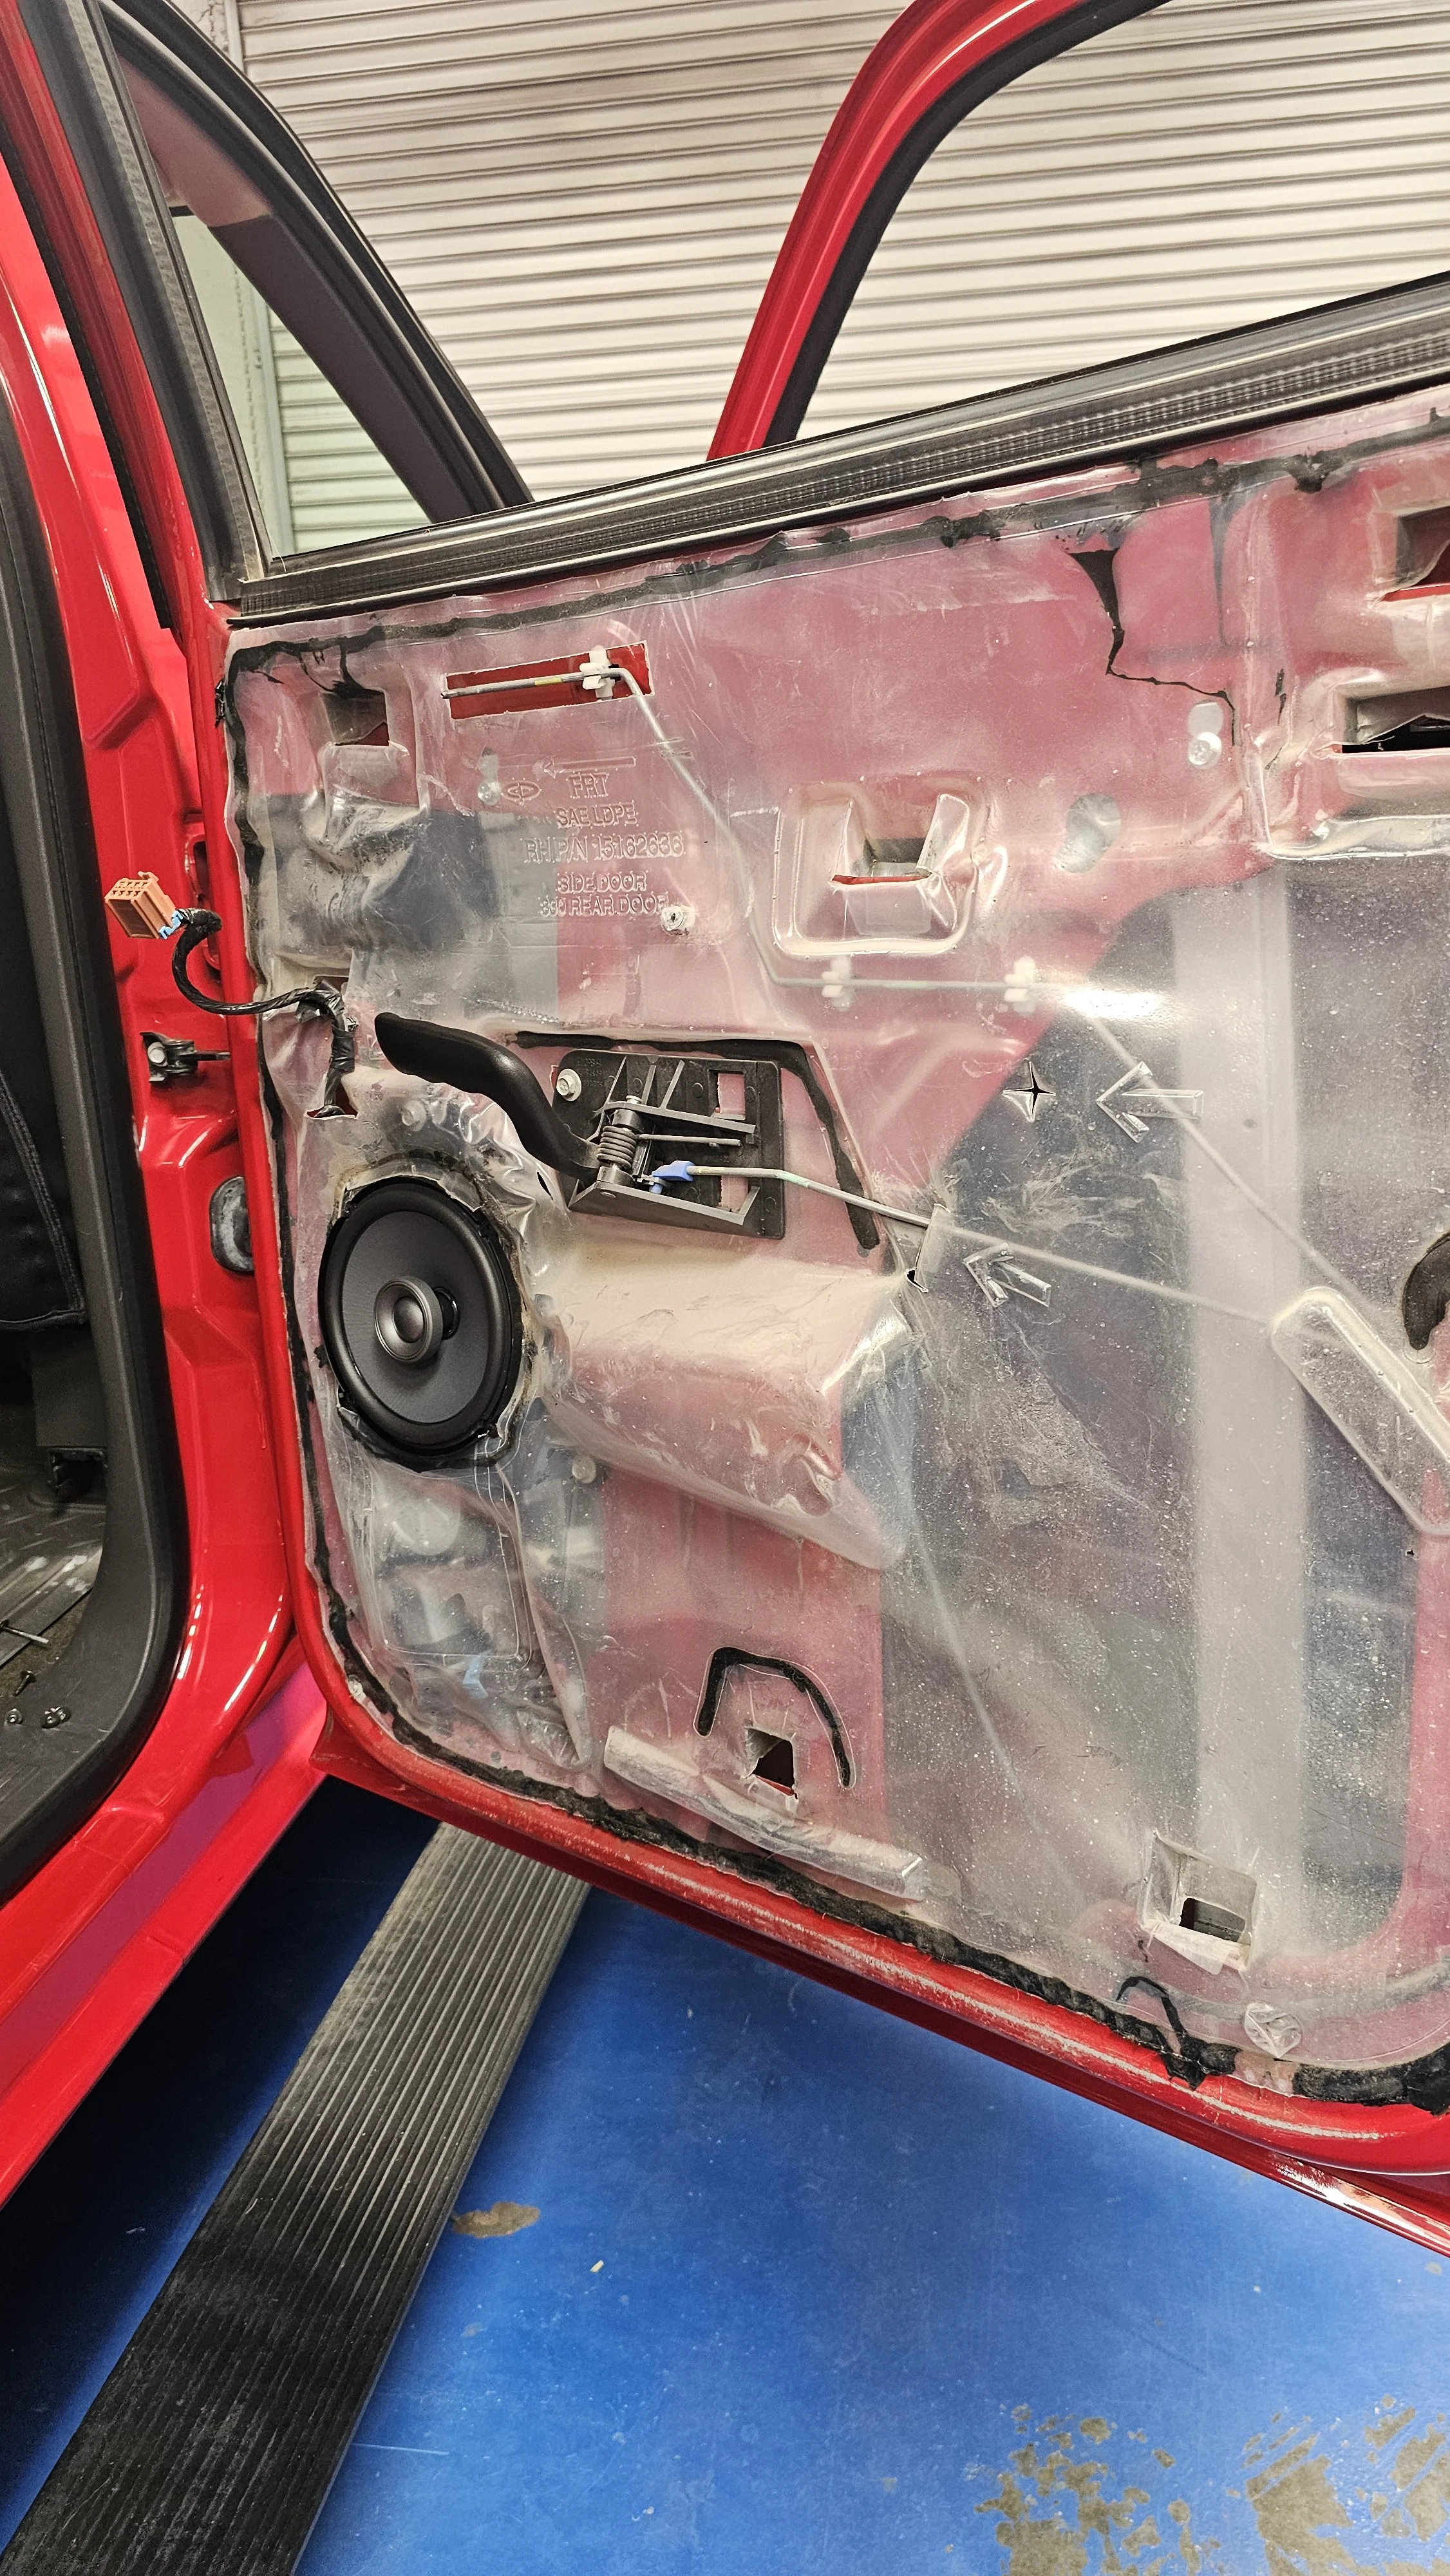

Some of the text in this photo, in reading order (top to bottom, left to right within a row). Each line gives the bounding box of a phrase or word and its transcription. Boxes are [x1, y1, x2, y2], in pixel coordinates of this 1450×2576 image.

[567, 772, 610, 799] FRT
[555, 803, 638, 829] SAE LDPE
[523, 837, 552, 864] RH
[553, 835, 588, 863] P/N
[557, 871, 648, 894] SIDE DOOR
[569, 895, 615, 916] REAR
